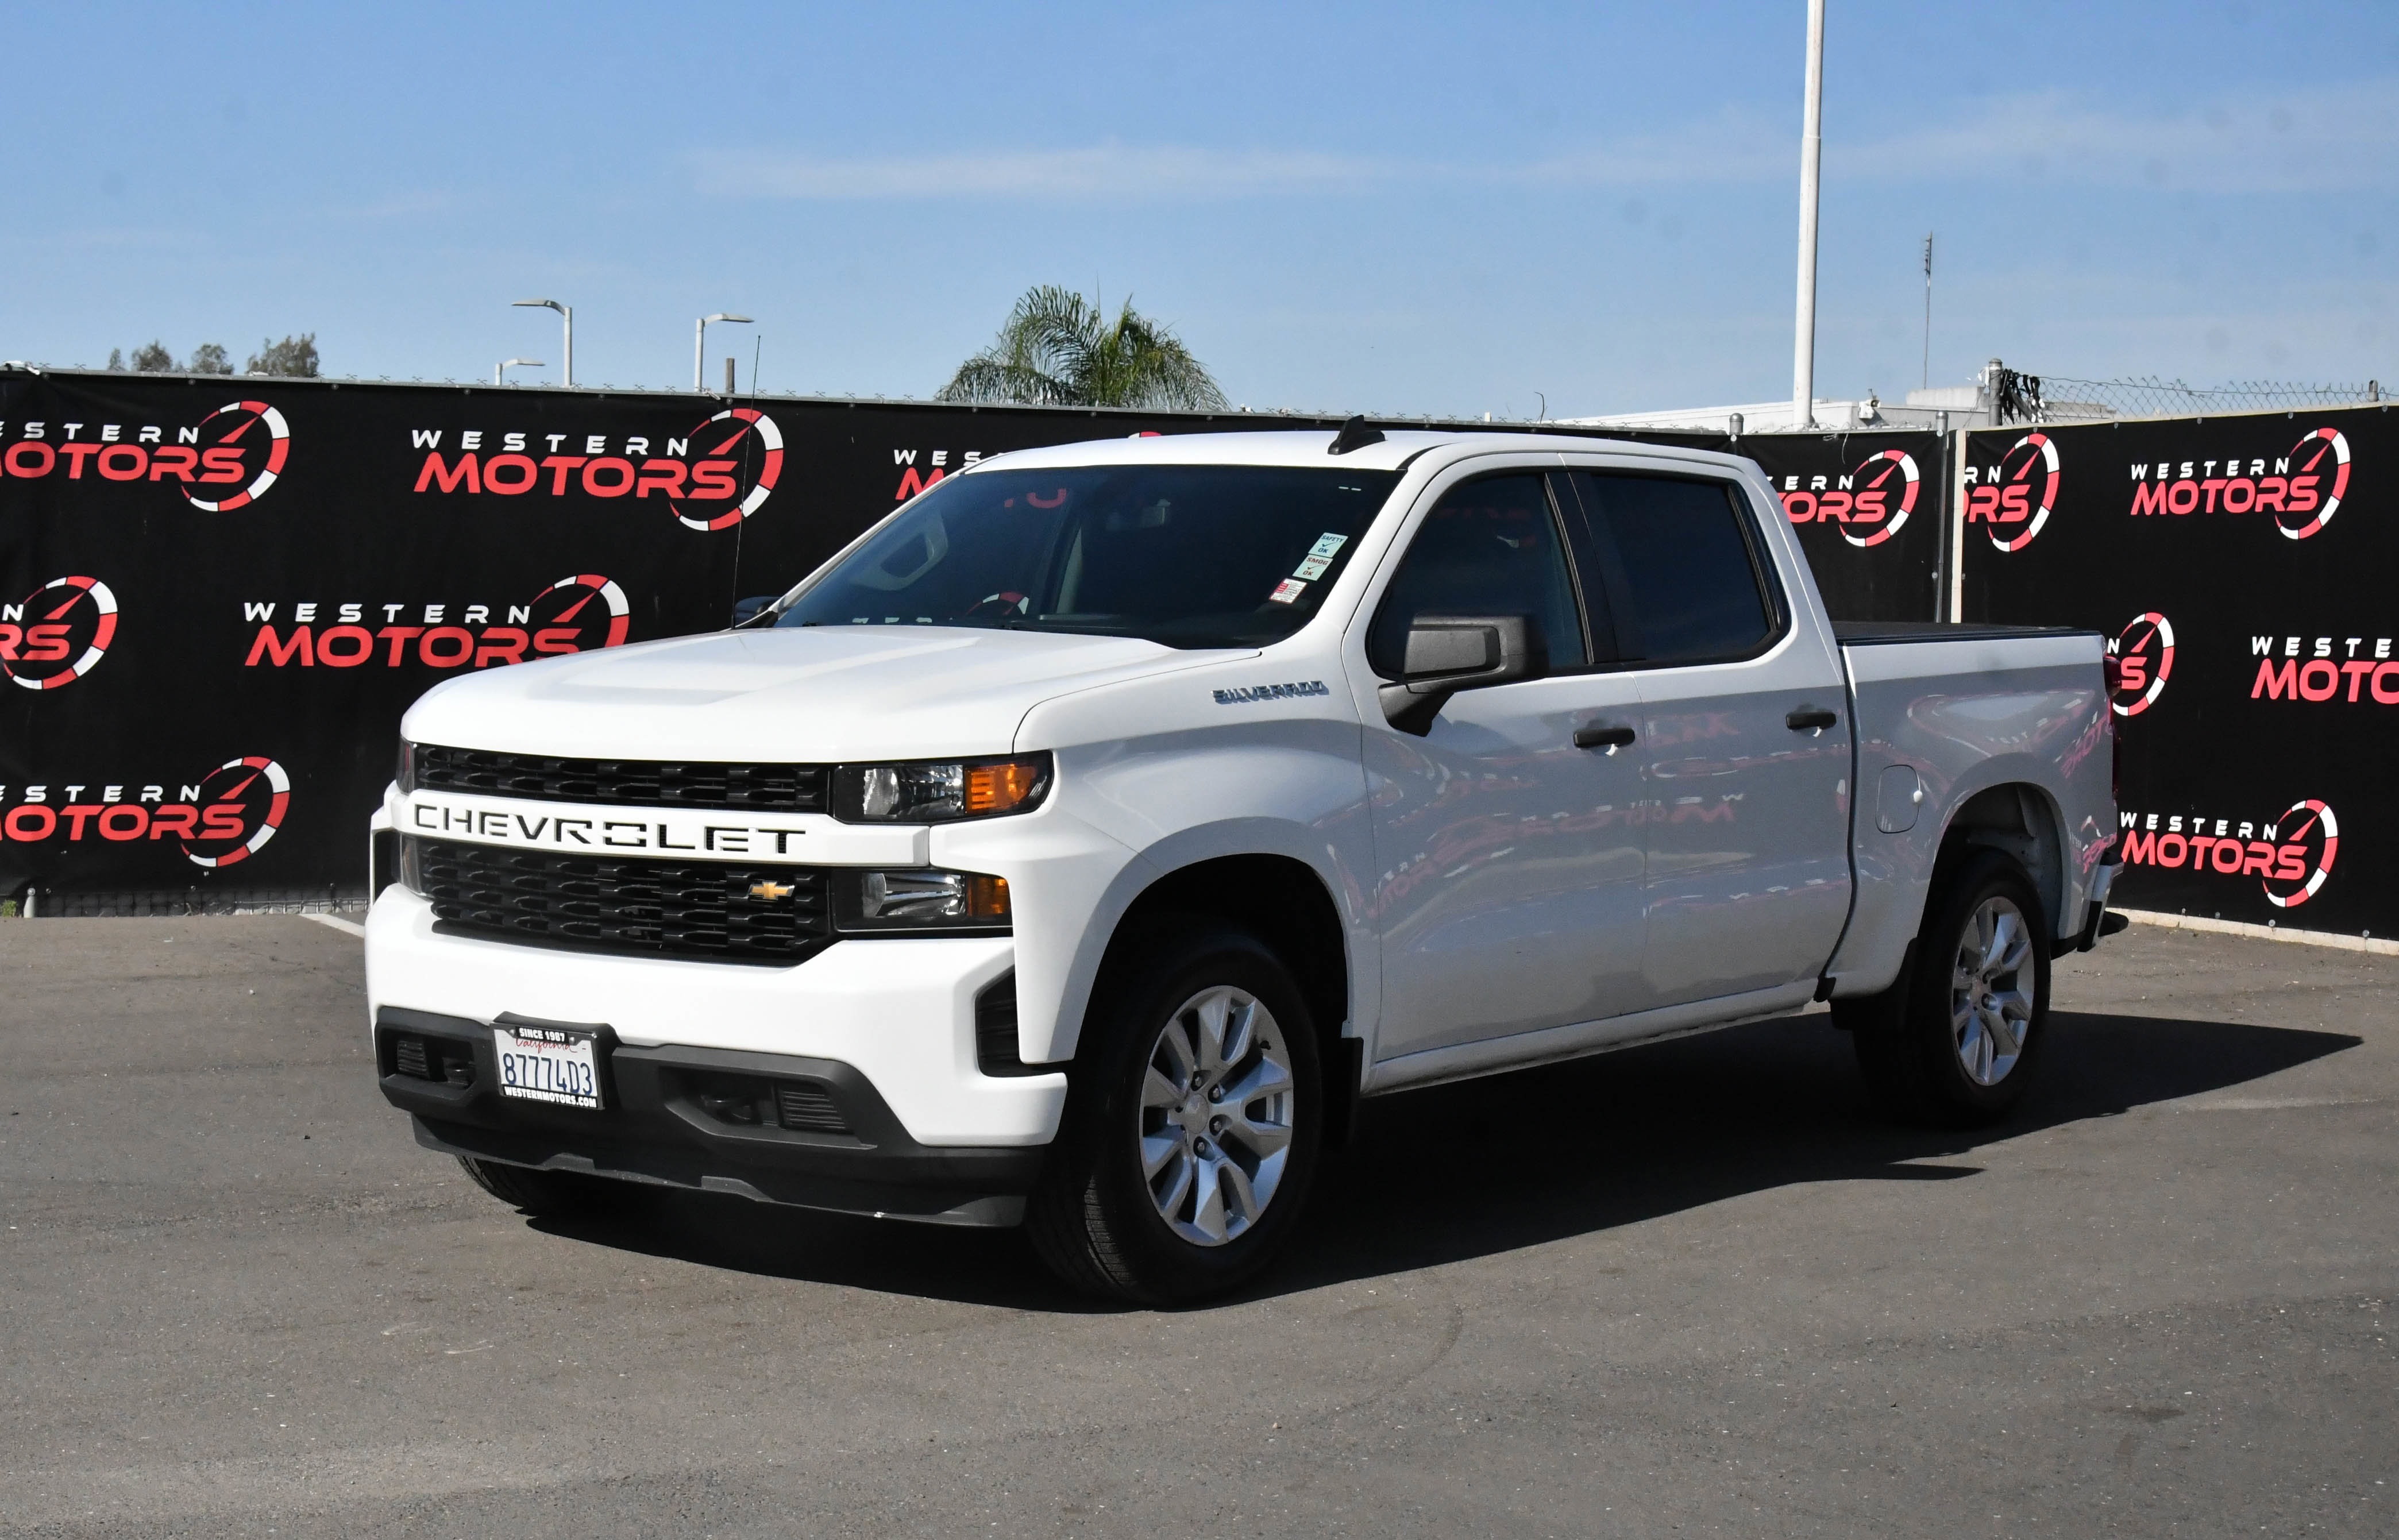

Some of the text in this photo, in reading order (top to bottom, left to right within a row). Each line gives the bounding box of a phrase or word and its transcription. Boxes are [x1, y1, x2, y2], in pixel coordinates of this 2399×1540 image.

[0, 422, 199, 444] STERN
[412, 430, 688, 456] WESTERN
[0, 441, 246, 483] OTORS
[414, 451, 738, 500] MOTORS
[2131, 457, 2289, 480] WESTERN
[1767, 474, 1854, 491] ERN
[2130, 475, 2320, 516] MOTORS
[1778, 491, 1888, 523] ORS
[1963, 484, 2031, 523] RS
[1321, 535, 1344, 543] SAFETY
[1306, 557, 1329, 566] SMOG
[244, 602, 530, 624] WESTERN
[245, 624, 581, 667] MOTORS
[2252, 636, 2393, 658] WESTE
[1211, 680, 1327, 704] SILVERADO
[2251, 658, 2399, 704] MOTO
[0, 785, 200, 802] STERN
[0, 804, 246, 842] OTORS
[414, 804, 805, 854] CHEVROLET
[2120, 812, 2278, 841] WESTERN
[2121, 830, 2308, 880] MOTORS
[519, 1028, 565, 1042] SINCE 1987
[503, 1052, 592, 1095] 87774D3
[504, 1086, 597, 1108] WESTERNMOTORS.COM
